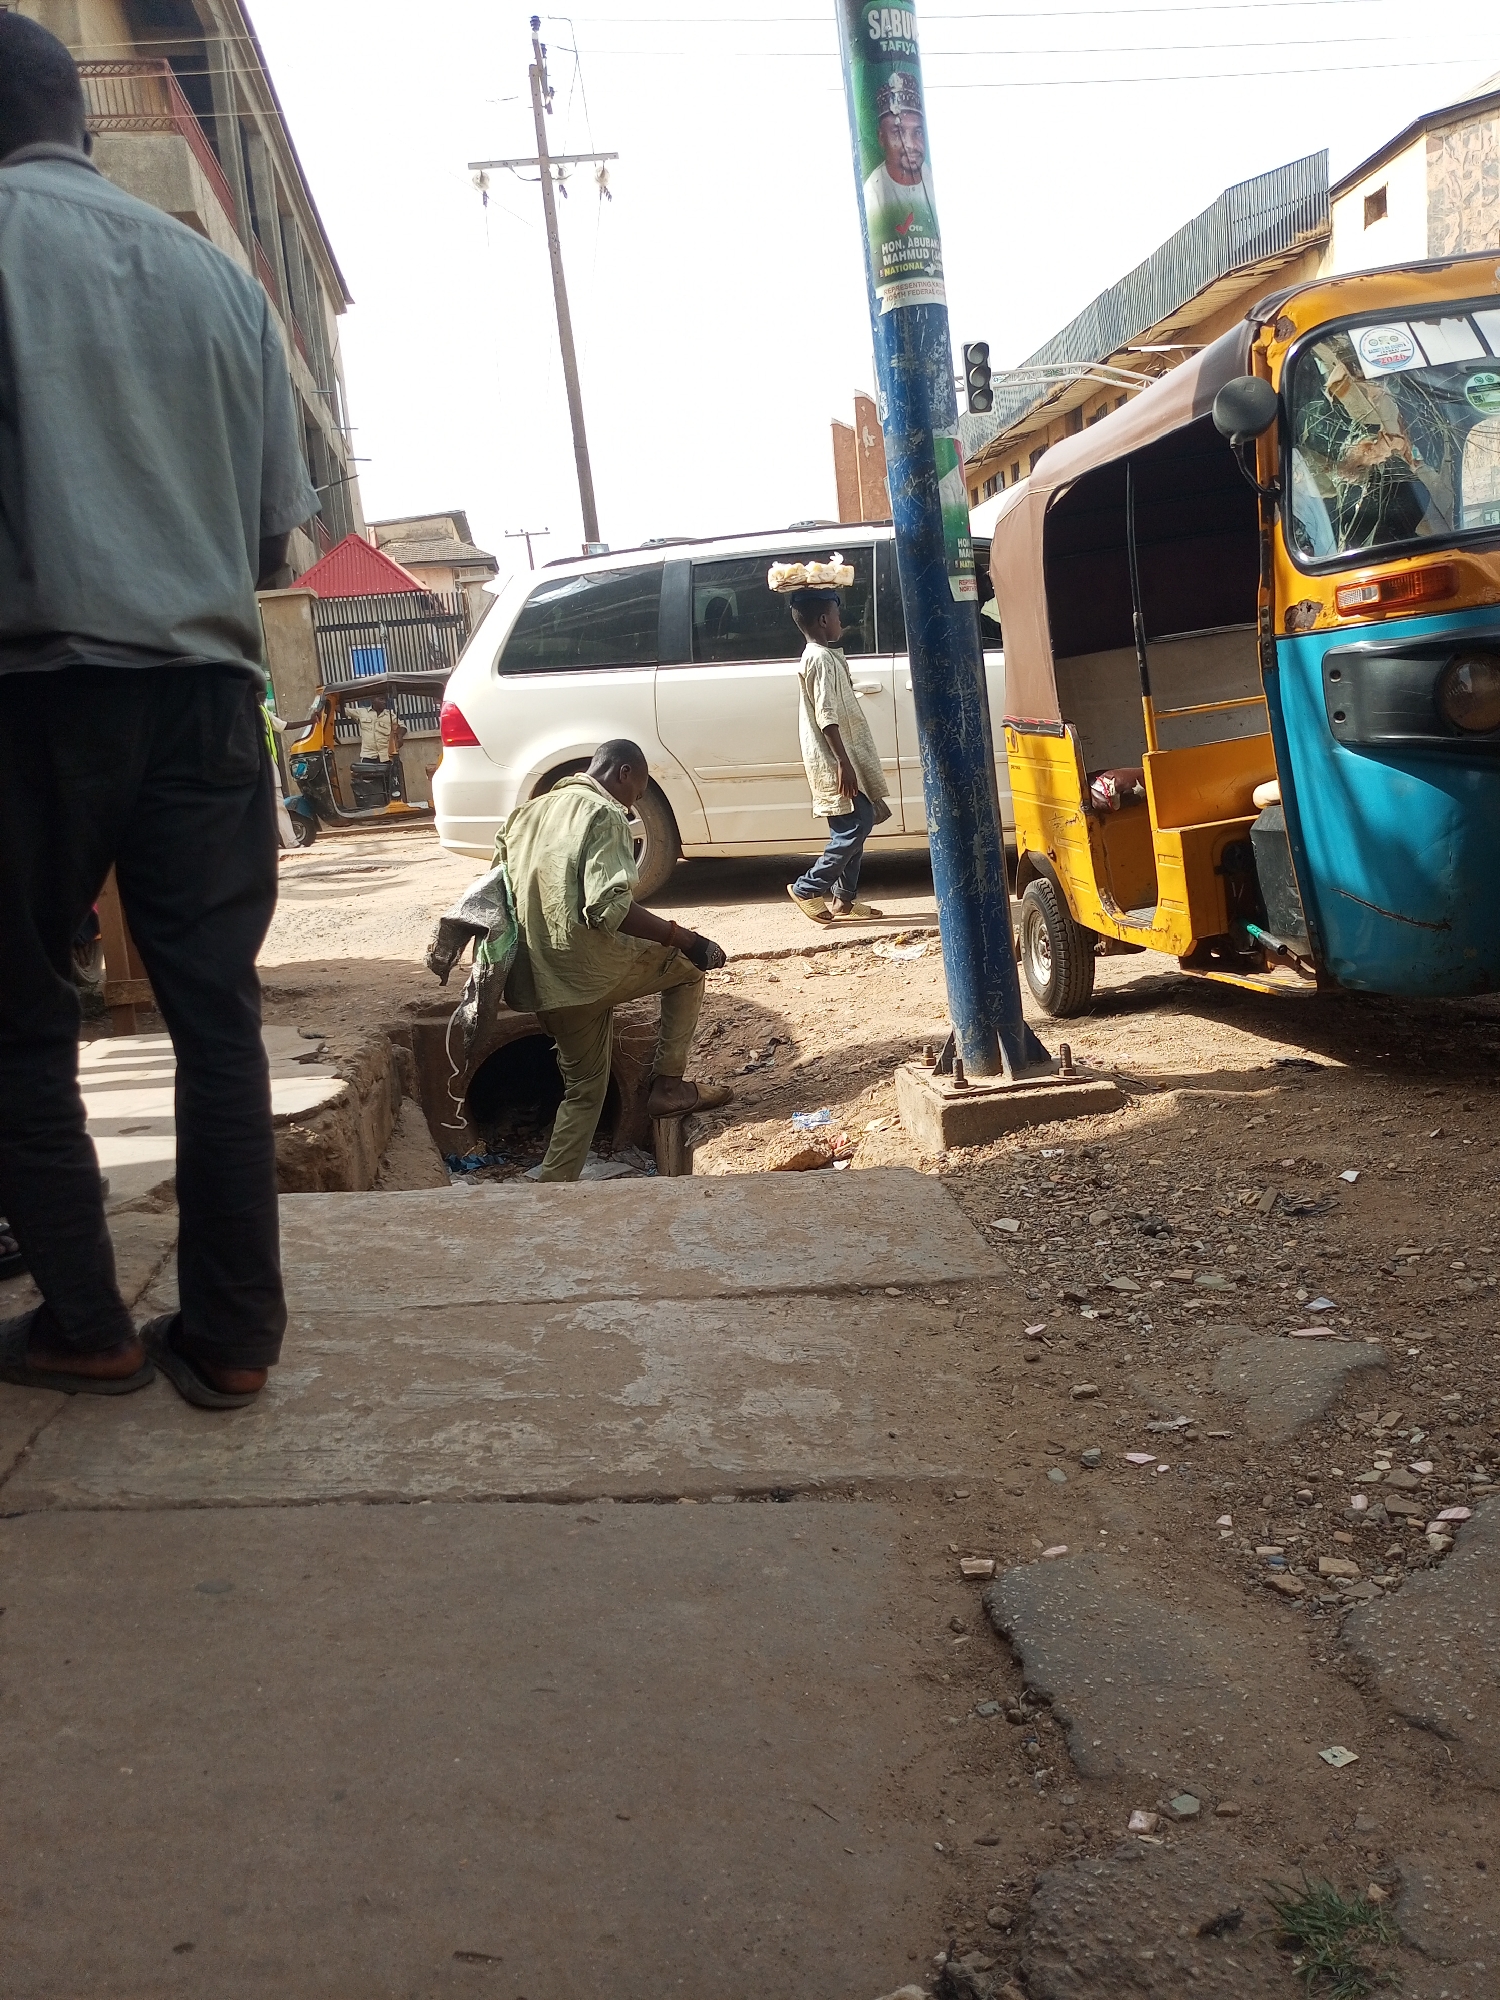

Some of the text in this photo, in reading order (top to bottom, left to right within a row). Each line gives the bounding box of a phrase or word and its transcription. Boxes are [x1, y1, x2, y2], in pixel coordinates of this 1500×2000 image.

[880, 41, 916, 55] TAFIYA
[882, 240, 905, 255] HON.
[883, 249, 930, 266] MAHMUD
[884, 262, 924, 277] NATIONAL
[884, 281, 931, 294] REPRESENTING
[908, 288, 935, 297] FEDERAL
